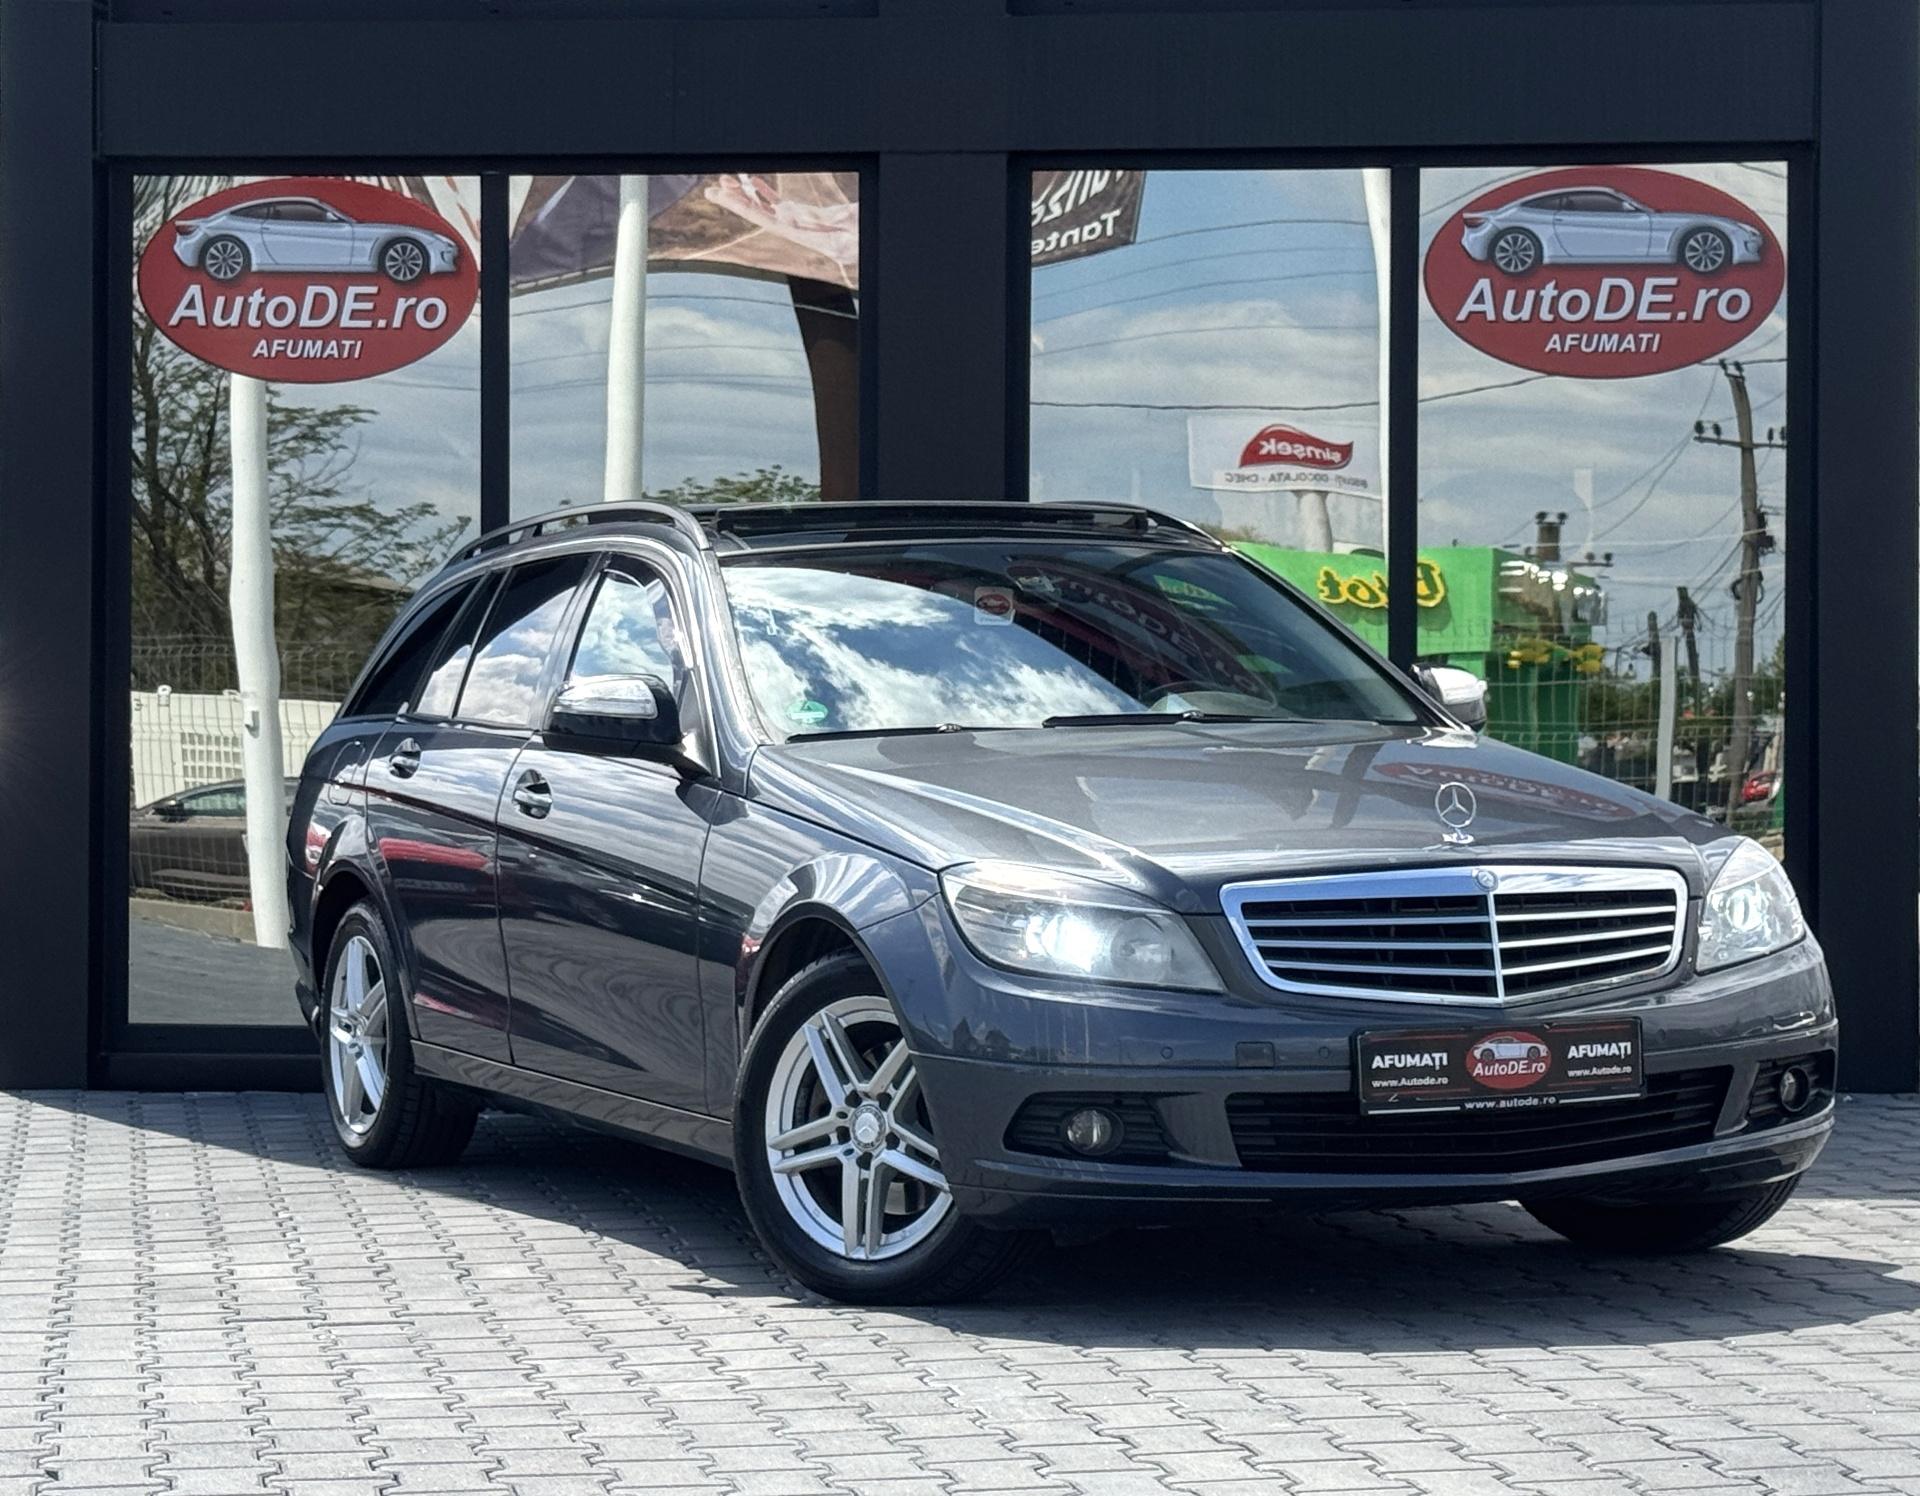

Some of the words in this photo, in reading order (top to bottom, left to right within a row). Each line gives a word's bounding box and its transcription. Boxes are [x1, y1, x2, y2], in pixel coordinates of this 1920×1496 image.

[168, 284, 448, 329] AutoDE.ro
[1456, 277, 1751, 322] AutoDE.ro
[252, 339, 363, 359] AFUMATI
[1545, 333, 1661, 353] AFUMATI
[1472, 1060, 1547, 1077] AutoDE.ro
[1371, 1076, 1449, 1088] www.Autode.ro
[1464, 1096, 1557, 1110] www.autode.ro
